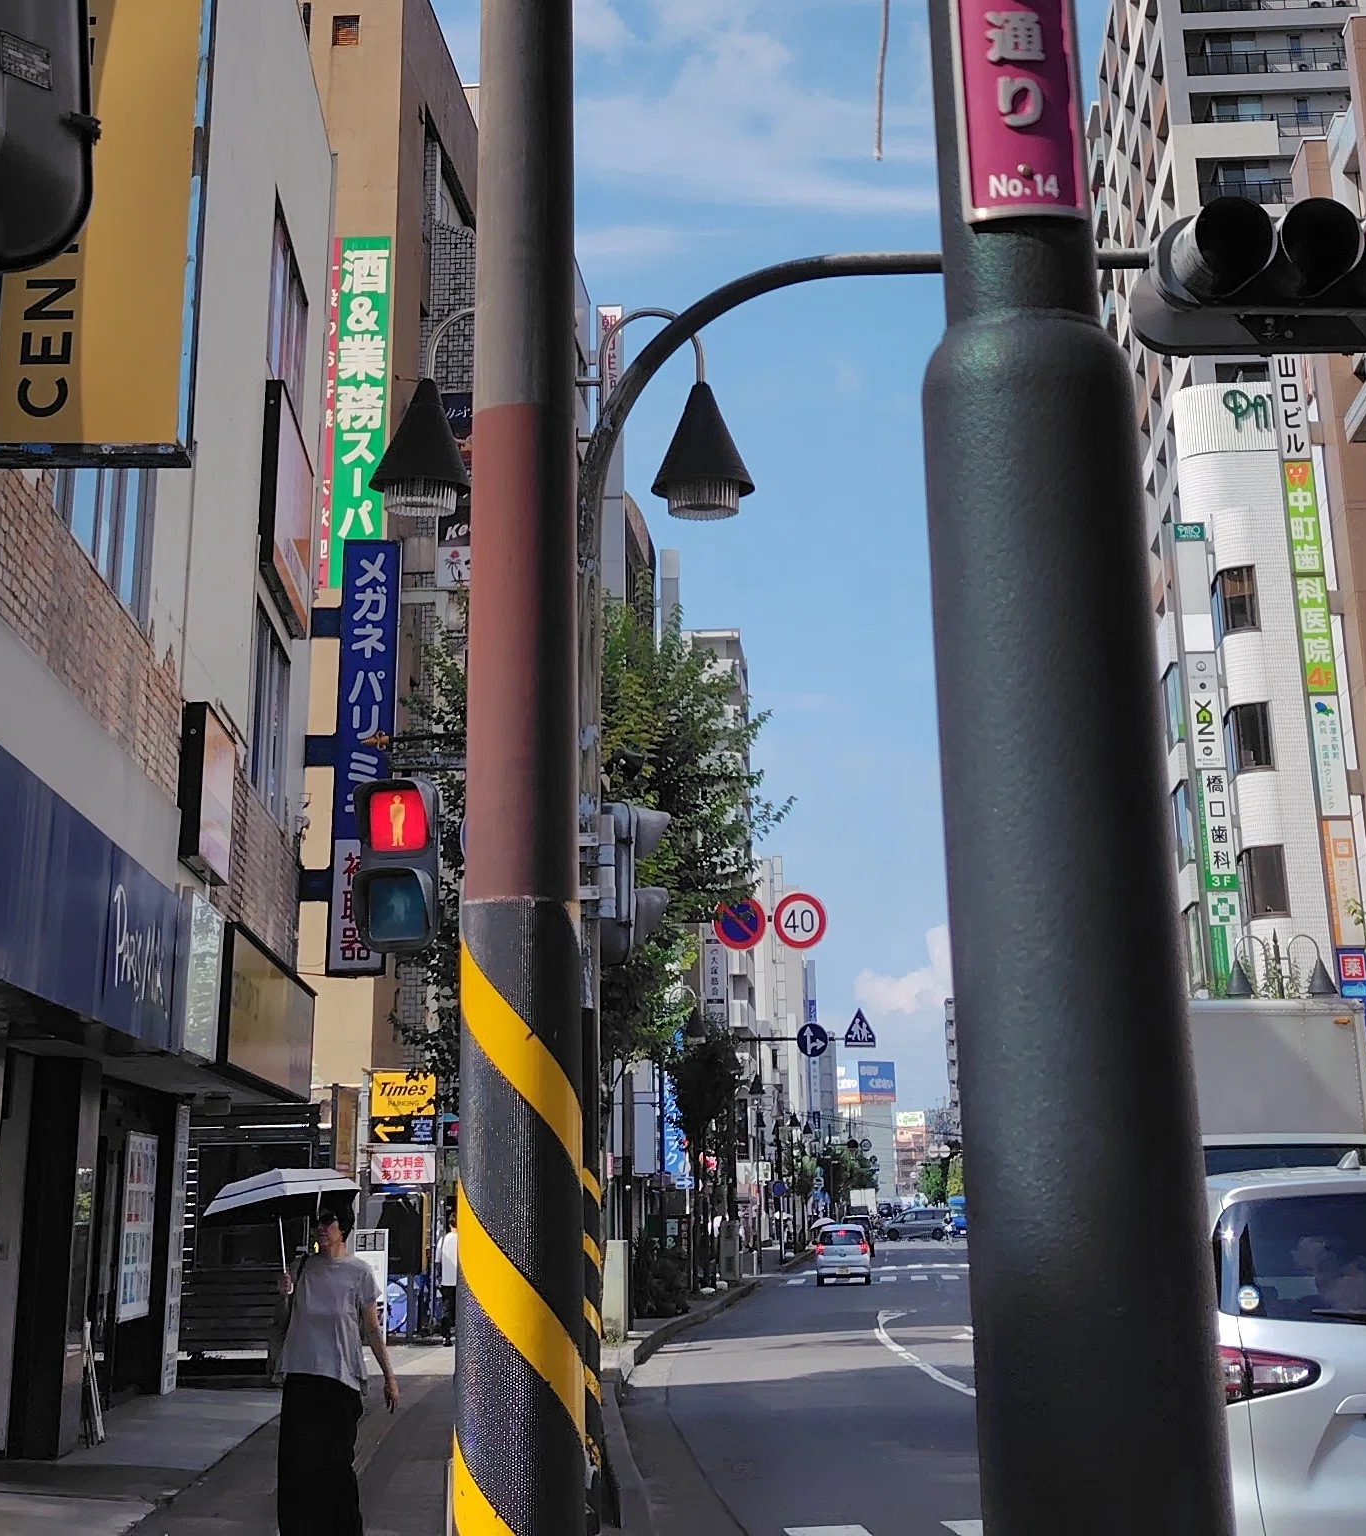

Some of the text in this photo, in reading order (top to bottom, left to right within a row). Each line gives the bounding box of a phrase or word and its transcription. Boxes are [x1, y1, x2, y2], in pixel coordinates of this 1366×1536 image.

[17, 243, 79, 418] CEN
[337, 249, 389, 540] 酒&業務スーパ
[445, 522, 471, 541] Ke
[1288, 487, 1332, 664] 中町歯科医院
[344, 552, 387, 812] メガネパリミ
[1207, 774, 1231, 870] 橋口歯科
[1211, 876, 1231, 887] 3F
[784, 909, 815, 934] 40
[379, 1081, 428, 1097] Times
[381, 1156, 425, 1168] 最大料金
[381, 1169, 424, 1181] あります
